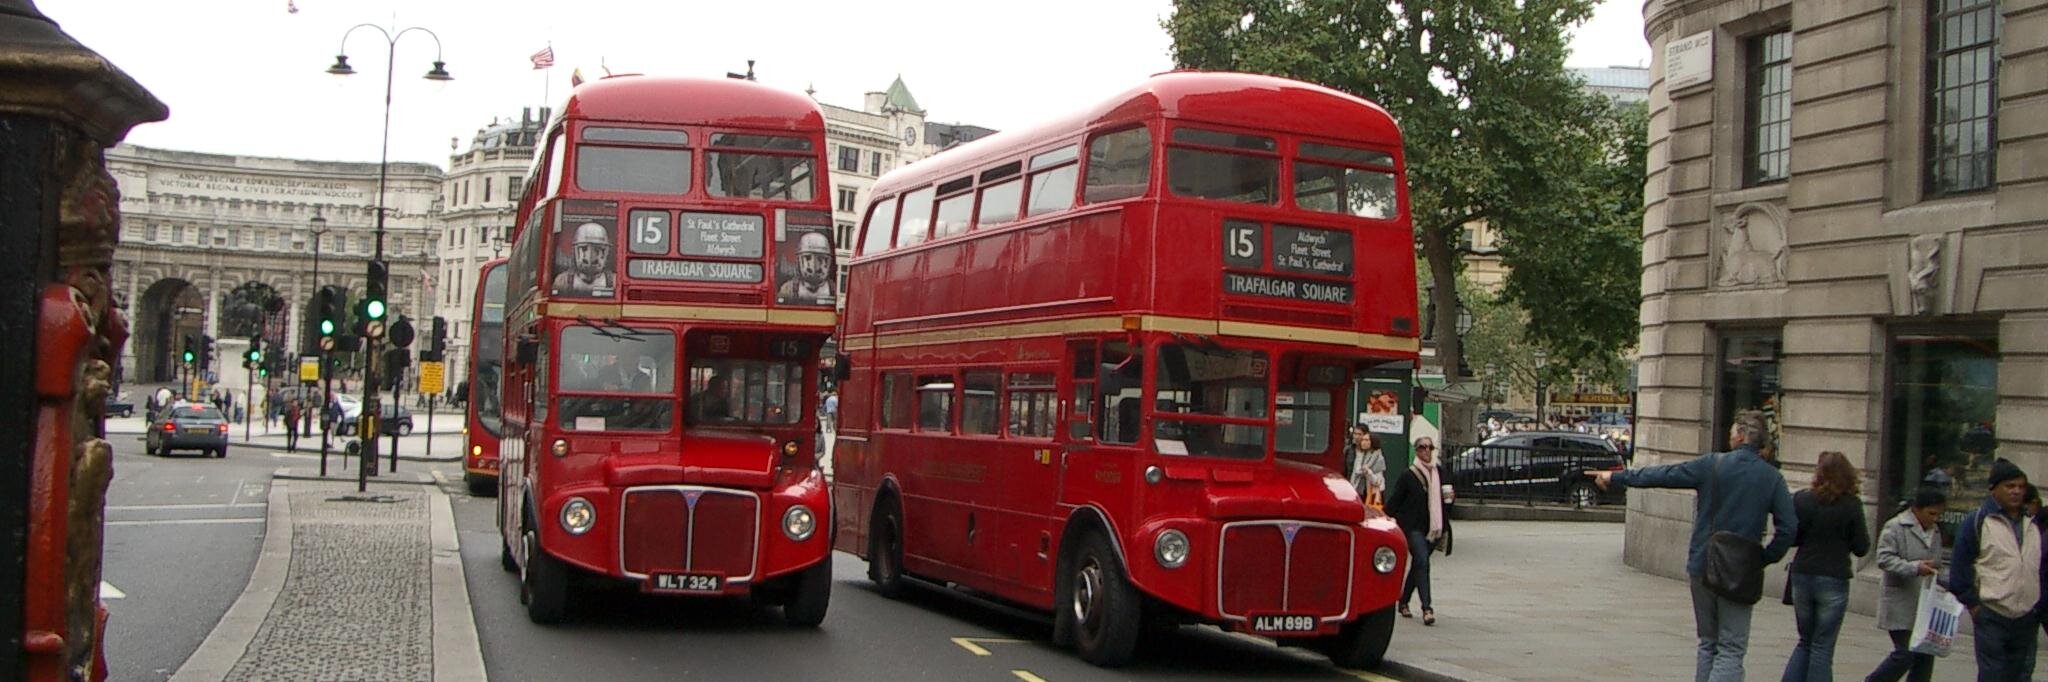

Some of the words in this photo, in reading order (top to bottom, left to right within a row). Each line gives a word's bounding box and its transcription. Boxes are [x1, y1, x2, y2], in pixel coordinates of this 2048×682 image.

[635, 216, 662, 244] 15
[687, 218, 696, 229] St
[697, 218, 720, 230] Paul's
[721, 219, 755, 232] Cathedral
[700, 231, 719, 242] Fleet
[720, 232, 742, 243] Street
[1229, 227, 1255, 258] 15
[1297, 231, 1326, 246] Aldwych
[706, 243, 736, 256] Aldwych
[1290, 243, 1309, 256] Fleet
[1311, 245, 1332, 259] Street
[641, 261, 704, 277] TRAFALGAR
[708, 263, 753, 280] SQUARE
[1277, 254, 1287, 267] St
[1288, 255, 1311, 269] Paul's
[1312, 258, 1345, 273] Cathedral
[1229, 274, 1297, 299] TRAFALGAR
[1301, 283, 1347, 303] SQUARE
[658, 574, 688, 589] WLT
[689, 575, 718, 590] 324
[1254, 616, 1284, 631] ALM
[1285, 615, 1314, 631] 89B
